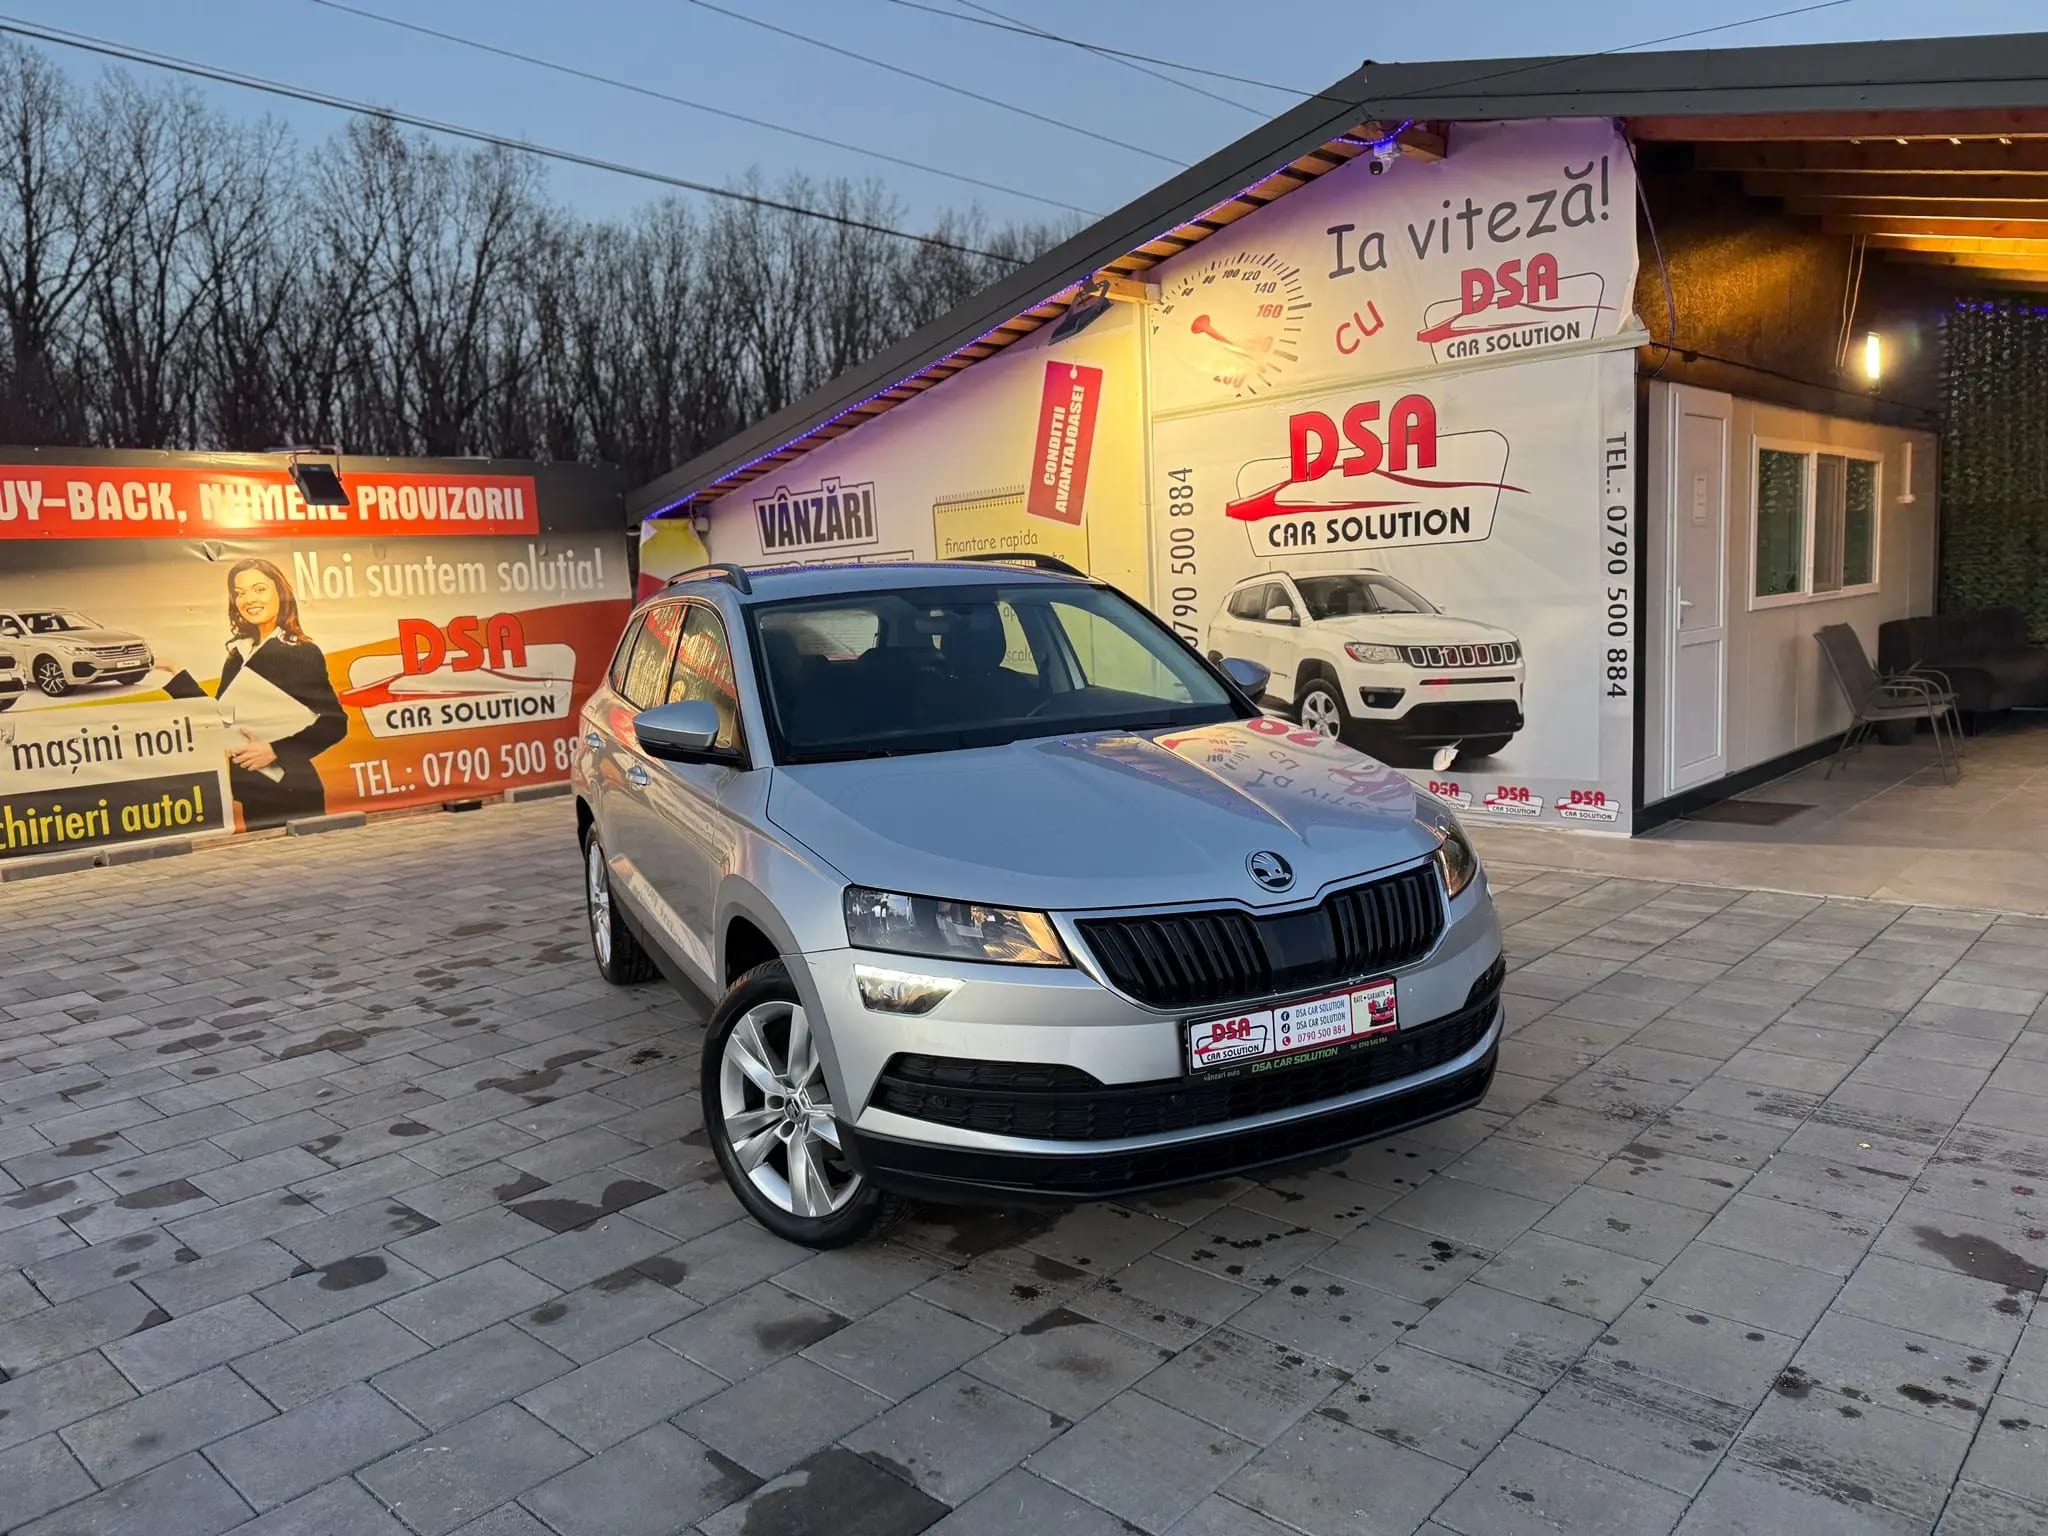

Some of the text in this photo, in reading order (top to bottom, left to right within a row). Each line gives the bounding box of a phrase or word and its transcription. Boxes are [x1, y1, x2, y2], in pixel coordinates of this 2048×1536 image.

[1327, 155, 1609, 279] Ia viteză!
[1222, 268, 1241, 279] 100
[1241, 270, 1262, 282] 120
[1254, 281, 1277, 294] 140
[1461, 252, 1558, 315] DSA
[1256, 303, 1283, 319] 160
[1336, 300, 1384, 355] cu
[1446, 320, 1580, 358] CAR SOLUTION
[1043, 406, 1066, 486] CONDITII
[1289, 393, 1437, 483] DSA
[356, 485, 524, 520] PROVIZORII
[1168, 468, 1194, 517] 884
[758, 485, 873, 548] VÂNZĂRI
[1268, 506, 1470, 547] CAR SOLUTION
[945, 529, 1038, 554] finantare rapida
[1169, 528, 1196, 575] 500
[1606, 505, 1628, 575] 0790
[293, 543, 605, 600] Noi suntem soluția!
[1607, 587, 1628, 637] 500
[398, 613, 527, 676] DSA
[1606, 648, 1628, 699] 884
[386, 695, 555, 730] CAR SOLUTION
[12, 716, 194, 775] mașini noi!
[350, 760, 416, 798] TEL.:
[422, 746, 490, 788] 0790
[500, 740, 547, 778] 500
[1429, 781, 1460, 797] DSA
[1497, 786, 1530, 801] DSA
[1571, 790, 1605, 806] DSA
[121, 785, 204, 832] auto!
[1506, 806, 1536, 815] SOLUTION
[1579, 811, 1612, 820] SOLUTION
[1296, 1000, 1345, 1018] DSA CAR SOLUTION
[1297, 1012, 1346, 1031] DSA CAR SOLUTION
[1212, 1018, 1251, 1043] DSA
[1298, 1024, 1346, 1043] 0790 500 884
[1207, 1044, 1260, 1062] CAR SOLUTION
[1252, 1047, 1339, 1074] DSA CAR SOLUTION
